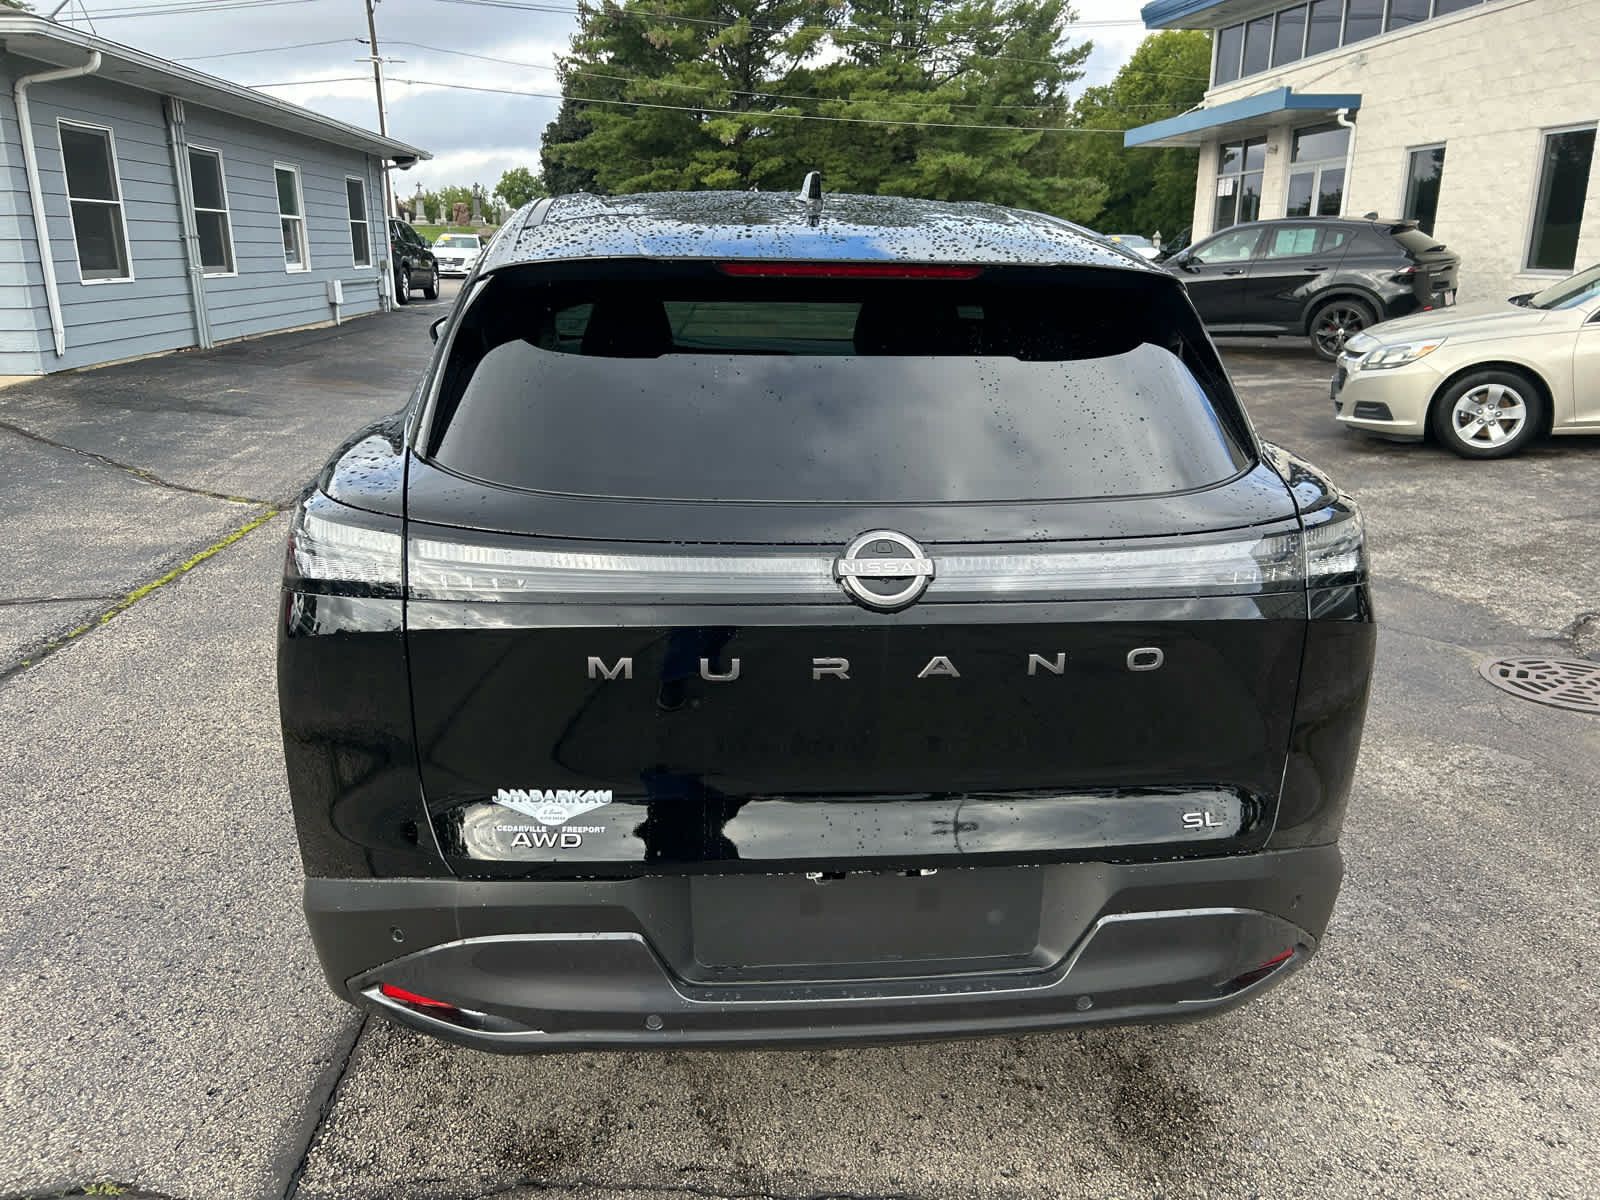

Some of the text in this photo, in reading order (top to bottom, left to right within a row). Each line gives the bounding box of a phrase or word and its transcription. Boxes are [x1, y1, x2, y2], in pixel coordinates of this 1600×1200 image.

[840, 561, 931, 573] NISSAN
[587, 647, 1164, 681] MURANO
[1182, 811, 1223, 828] SL
[496, 824, 606, 833] CEDARVILLE FREEPORT
[510, 832, 583, 848] AWD
